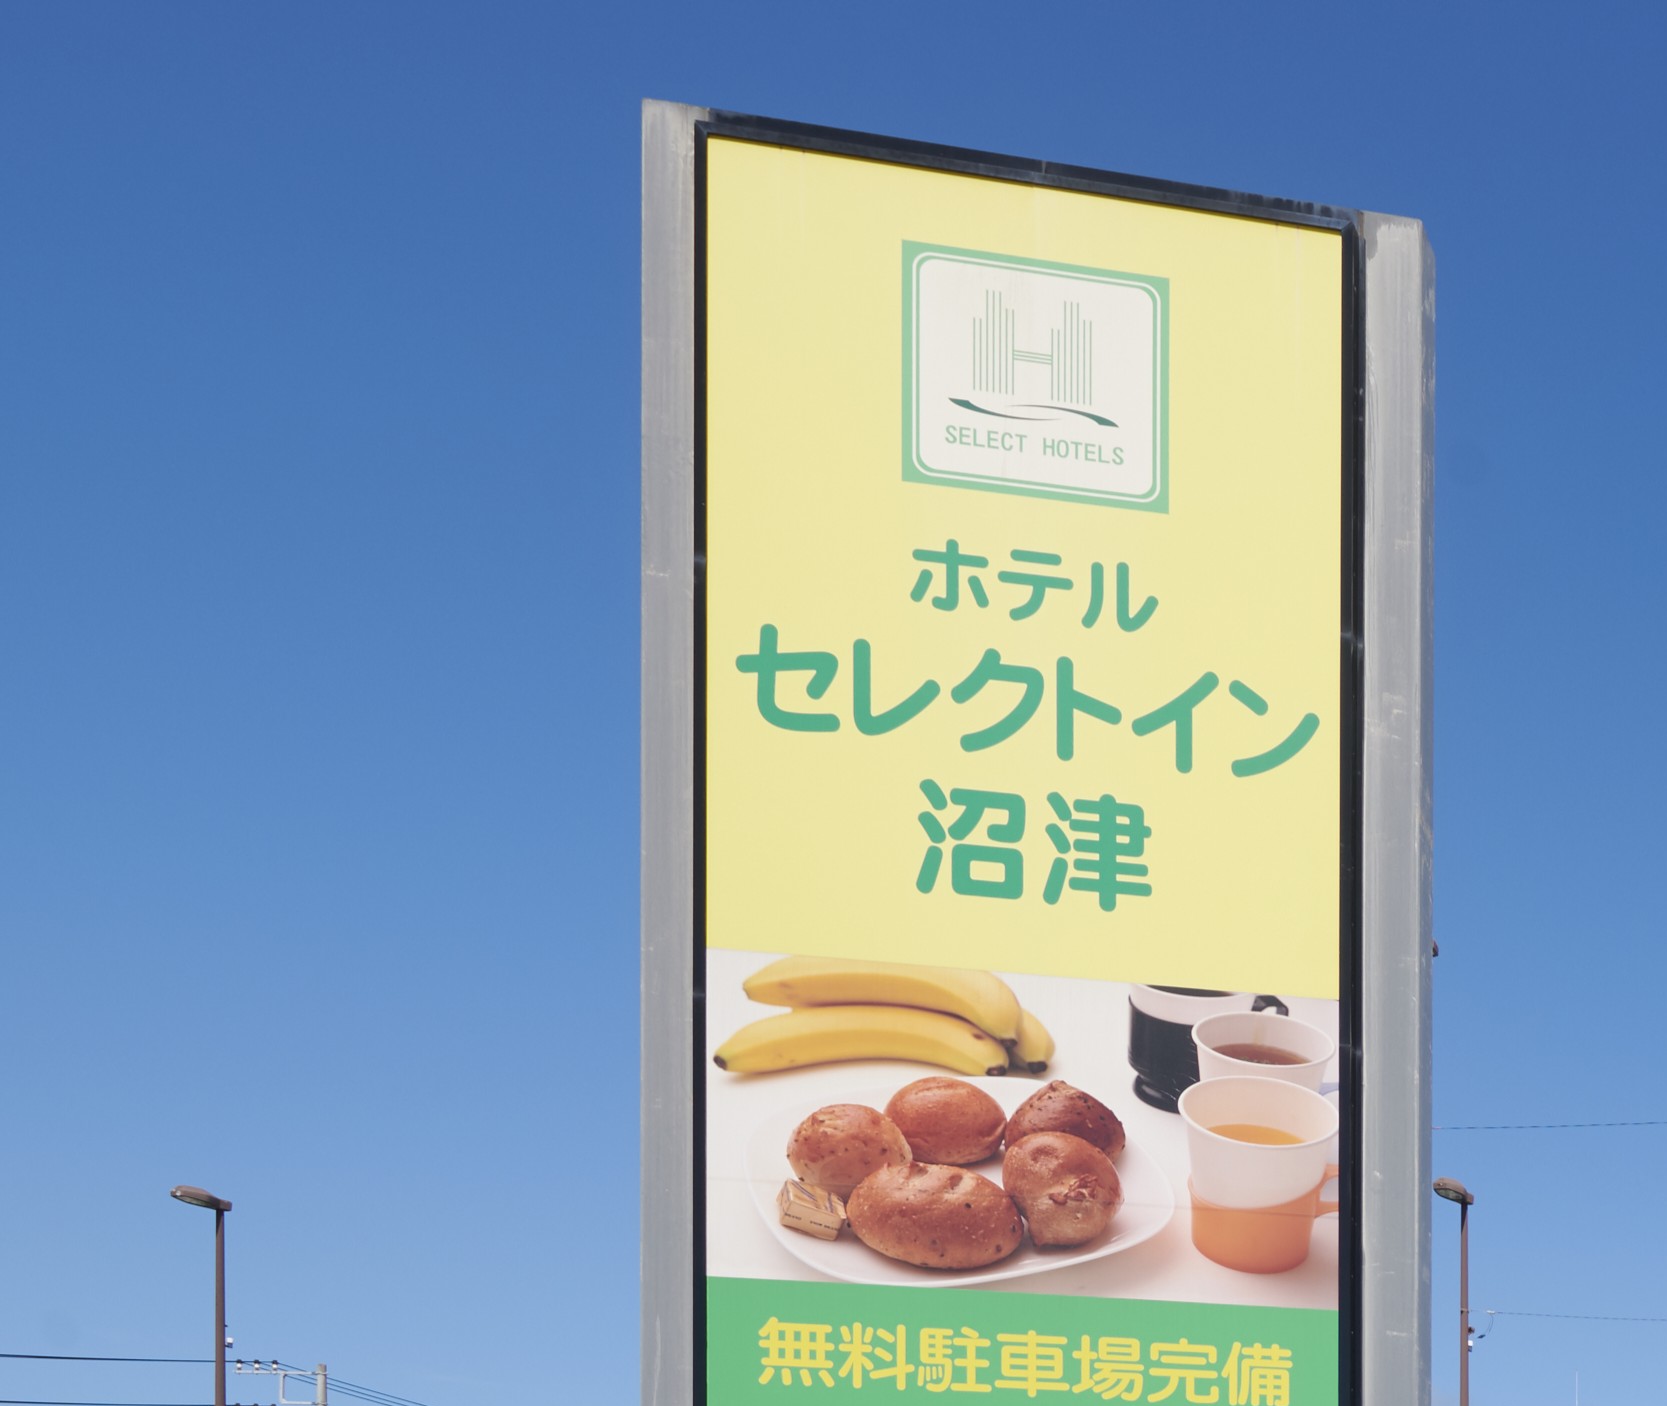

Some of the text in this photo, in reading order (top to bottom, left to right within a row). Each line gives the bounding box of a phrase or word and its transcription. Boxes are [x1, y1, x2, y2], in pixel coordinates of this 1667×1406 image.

[944, 424, 1125, 466] SELECT HOTELS
[910, 538, 1158, 632] ホテル
[735, 623, 1320, 778] セレクトイン
[916, 778, 1152, 912] 沼津
